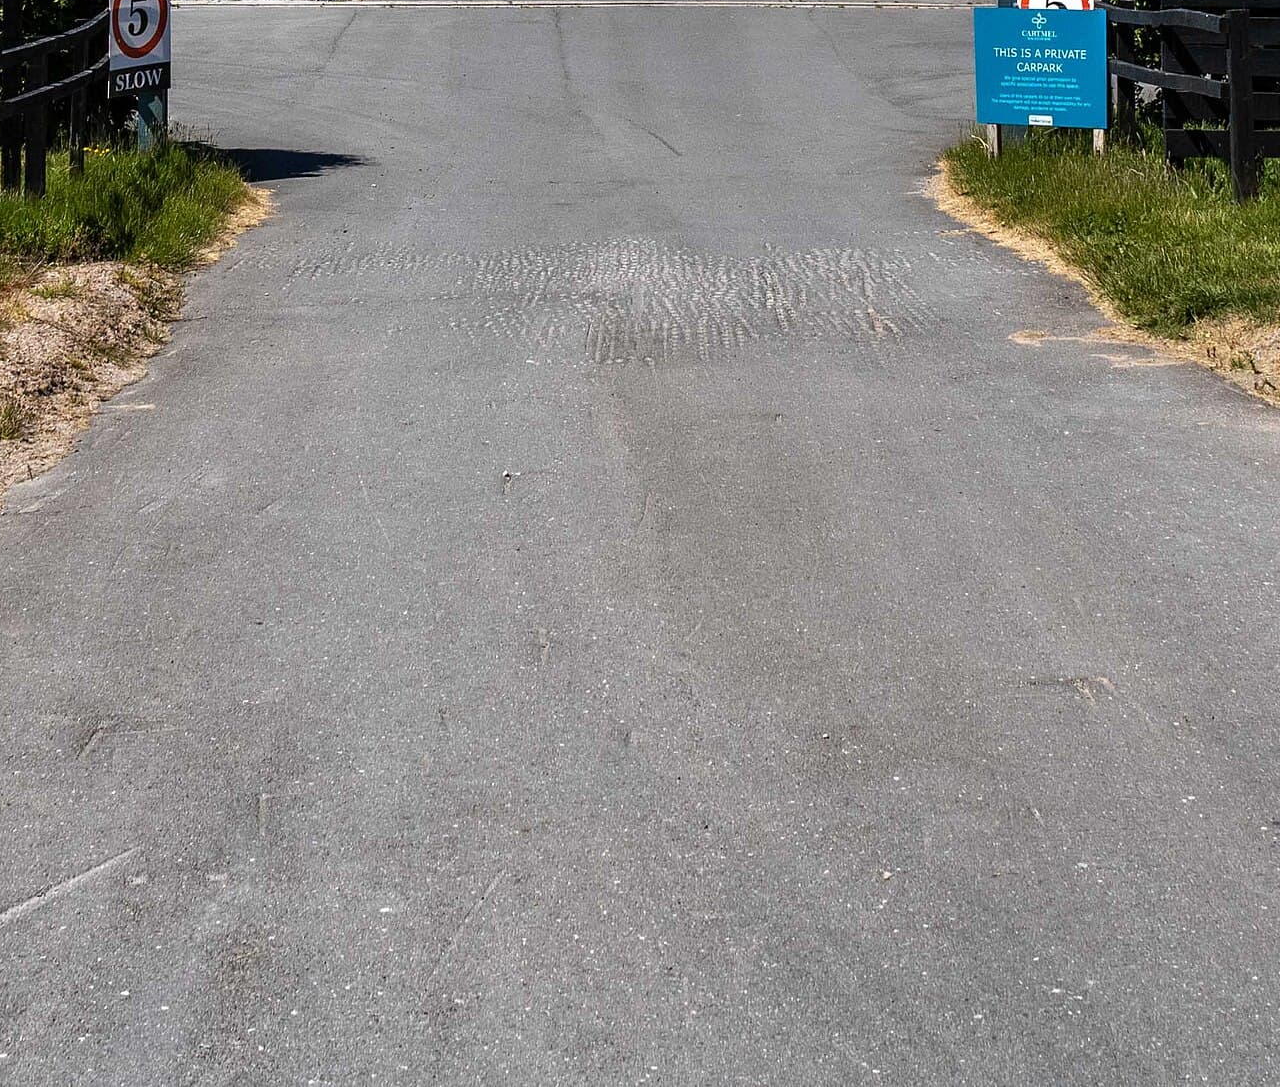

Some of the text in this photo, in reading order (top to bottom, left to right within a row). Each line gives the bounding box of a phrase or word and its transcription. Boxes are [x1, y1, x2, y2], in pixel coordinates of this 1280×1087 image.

[993, 47, 1087, 60] THIS IS A PRIVATE
[1016, 62, 1063, 73] CARPARK
[115, 67, 163, 92] SLOW
